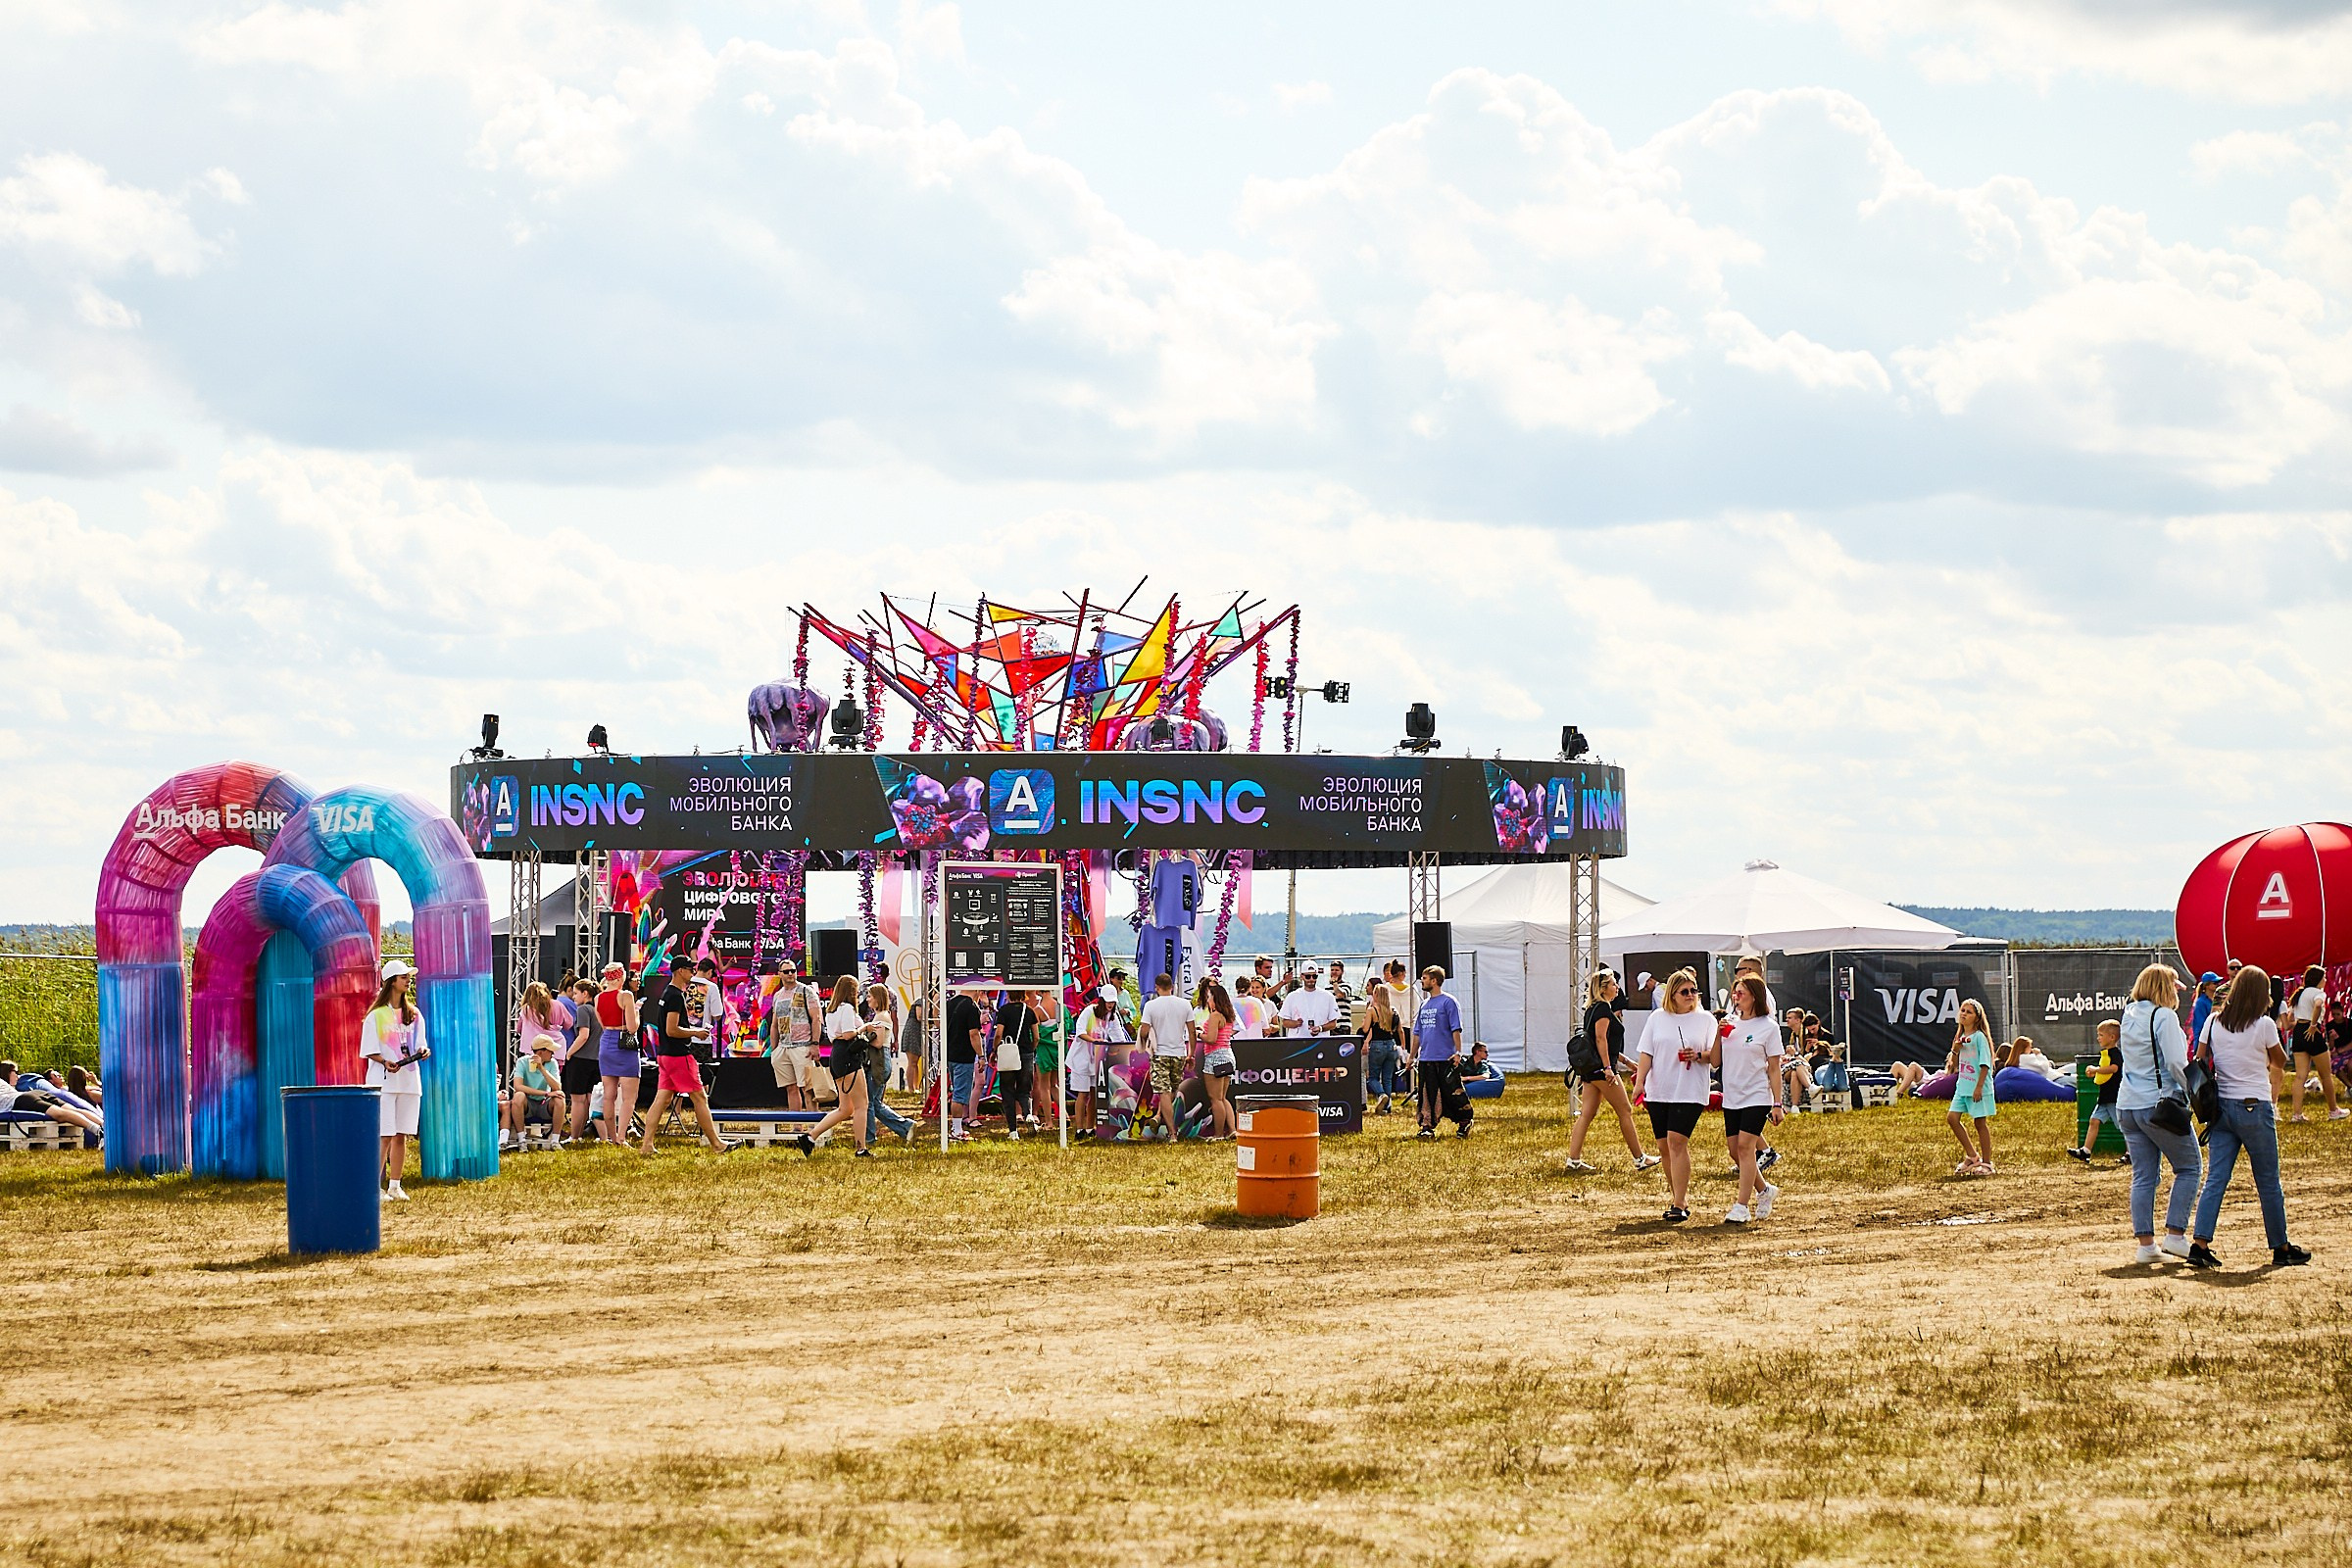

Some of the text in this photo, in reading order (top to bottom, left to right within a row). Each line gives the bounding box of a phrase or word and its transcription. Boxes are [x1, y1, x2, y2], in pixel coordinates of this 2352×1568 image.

[689, 777, 792, 795] ЭВОЛЮЦИЯ
[1323, 777, 1422, 796] ЭВОЛЮЦИЯ
[530, 782, 645, 826] INSNC
[670, 796, 792, 811] МОБИЛЬНОГО
[1081, 779, 1266, 824] INSNC
[1299, 796, 1422, 812] МОБИЛЬНОГО
[1583, 789, 1624, 830] INSNC
[135, 802, 288, 834] Альфа Банк
[312, 805, 374, 833] VISA
[732, 815, 793, 831] БАНКА
[1367, 816, 1422, 832] БАНКА
[1183, 946, 1193, 983] Extra
[1873, 988, 1960, 1024] VISA
[2045, 992, 2093, 1016] Альфа
[1229, 1066, 1348, 1086] НФОЦЕНТР
[1317, 1106, 1344, 1117] VISA
